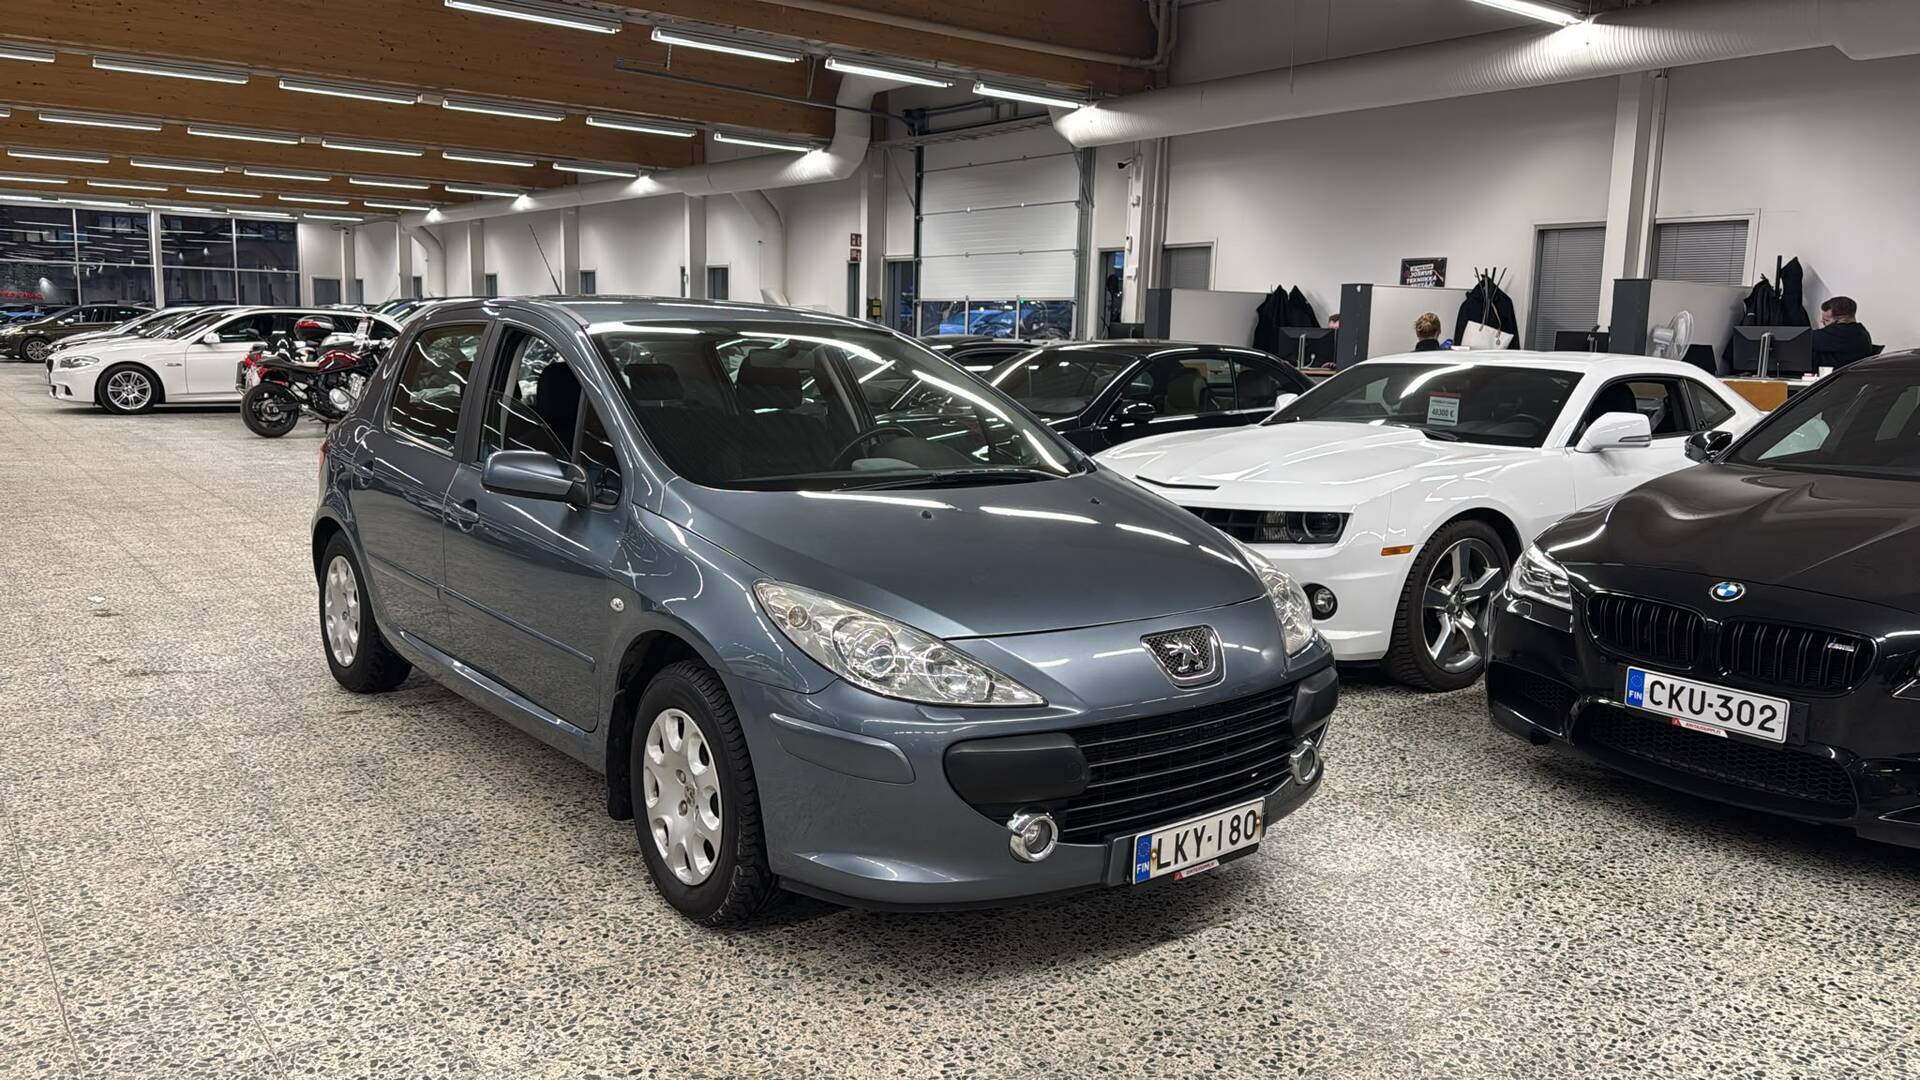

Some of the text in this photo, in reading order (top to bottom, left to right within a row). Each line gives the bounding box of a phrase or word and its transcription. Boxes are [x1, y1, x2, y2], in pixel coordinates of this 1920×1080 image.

[1450, 410, 1455, 418] €
[1629, 690, 1643, 700] FIN
[1650, 680, 1777, 733] CKU-302
[1157, 809, 1257, 870] LKY-180
[1136, 861, 1150, 873] FIN
